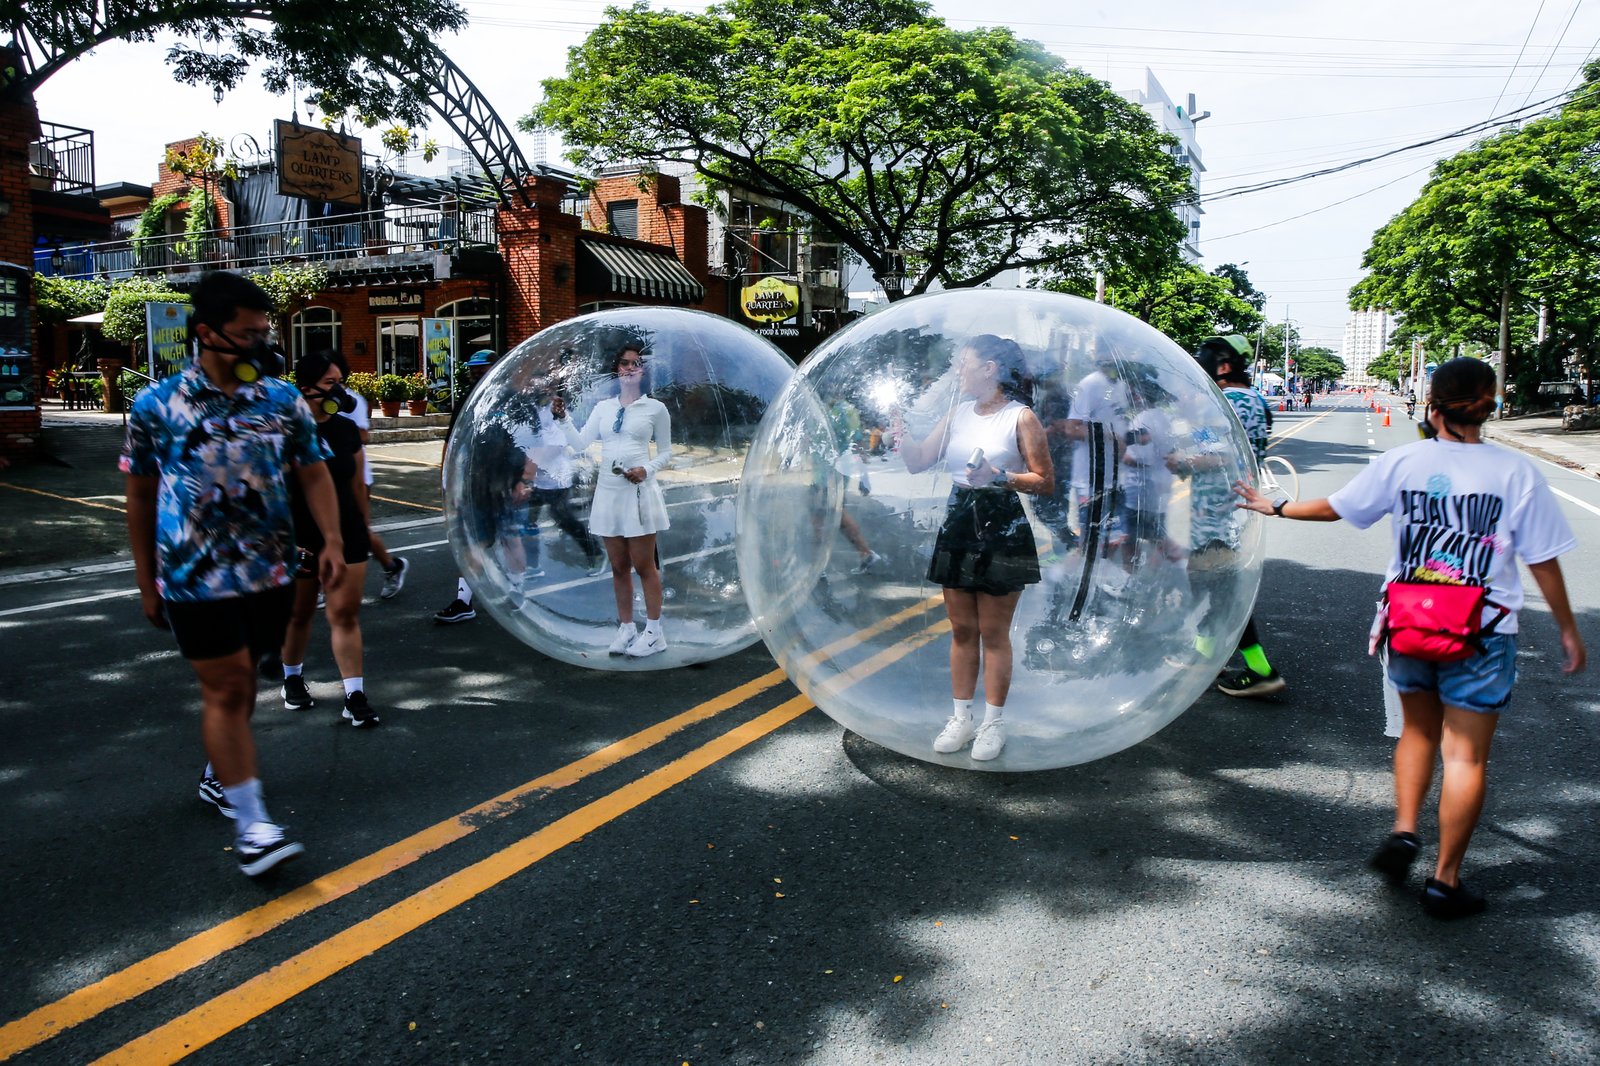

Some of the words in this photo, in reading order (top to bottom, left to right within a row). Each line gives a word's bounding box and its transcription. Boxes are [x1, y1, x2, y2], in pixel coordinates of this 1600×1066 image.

[303, 151, 340, 167] LAMP
[291, 162, 353, 185] QUARTERS
[753, 291, 783, 300] LAMP
[744, 300, 793, 310] QUARTERS
[153, 326, 188, 344] WEEKEN
[160, 344, 187, 361] NIGHT
[1400, 489, 1452, 528] PEDAL
[1452, 493, 1503, 537] YOUR
